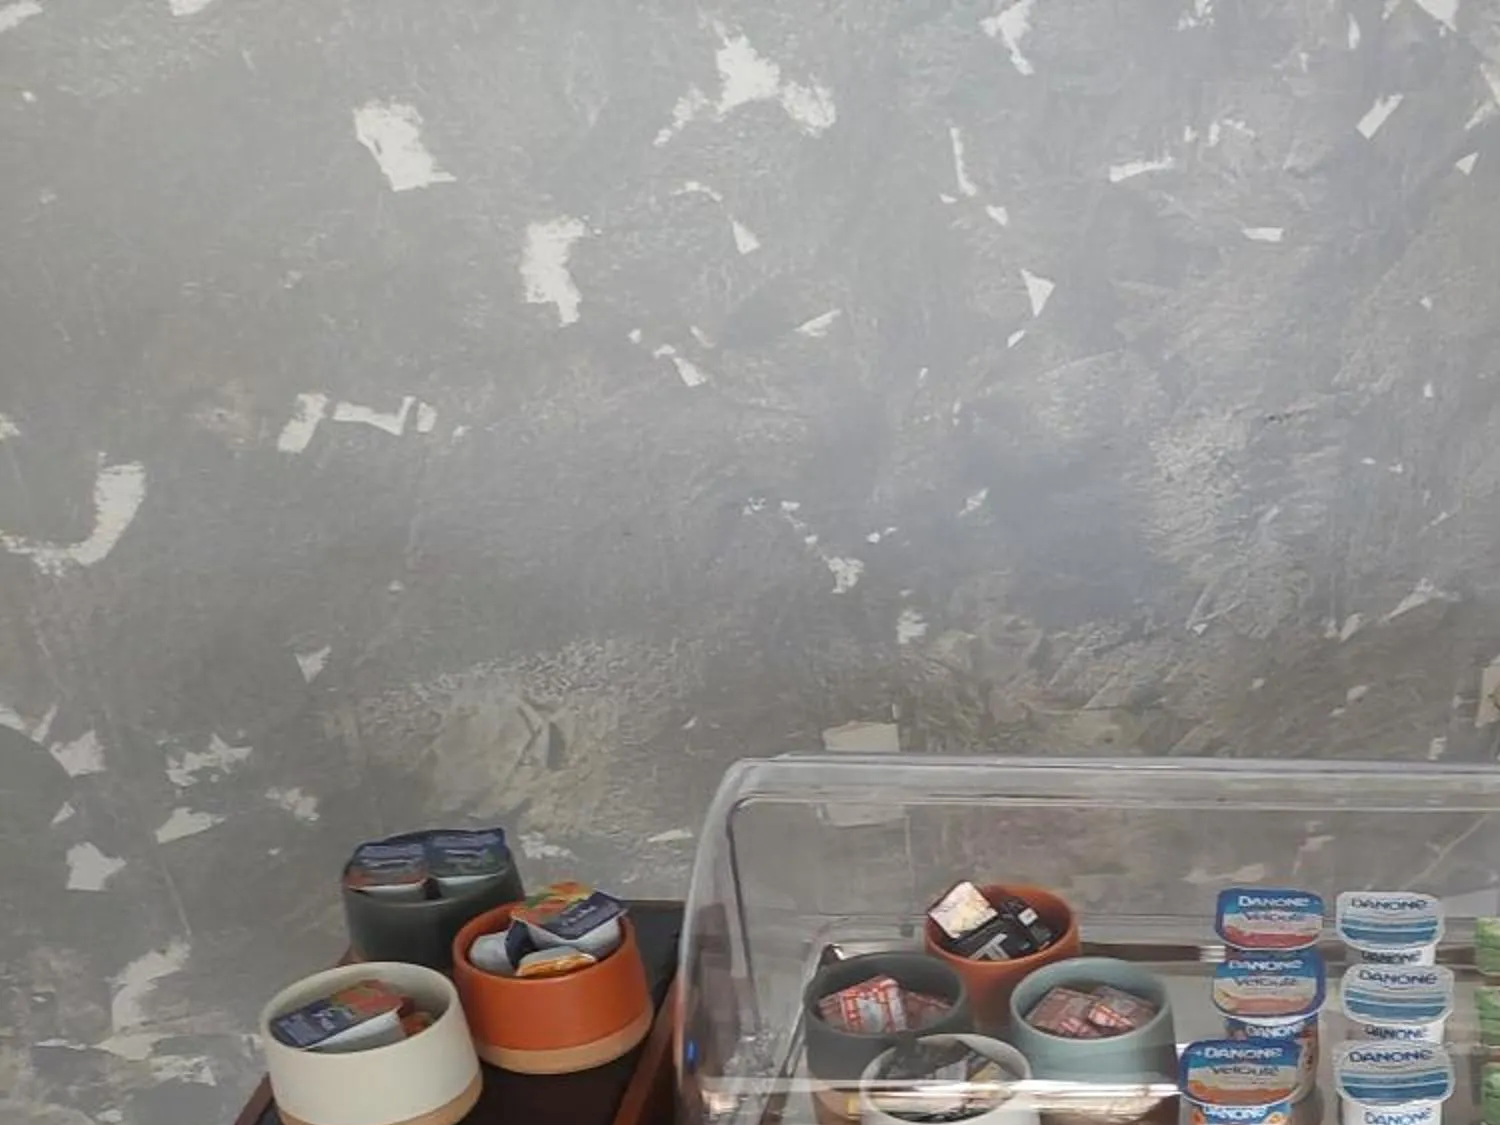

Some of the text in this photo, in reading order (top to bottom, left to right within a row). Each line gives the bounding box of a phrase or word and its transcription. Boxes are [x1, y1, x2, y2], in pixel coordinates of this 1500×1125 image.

[1359, 969, 1437, 985] DANONE
[1204, 1047, 1283, 1058] DANONE
[1349, 1050, 1433, 1063] DANONE
